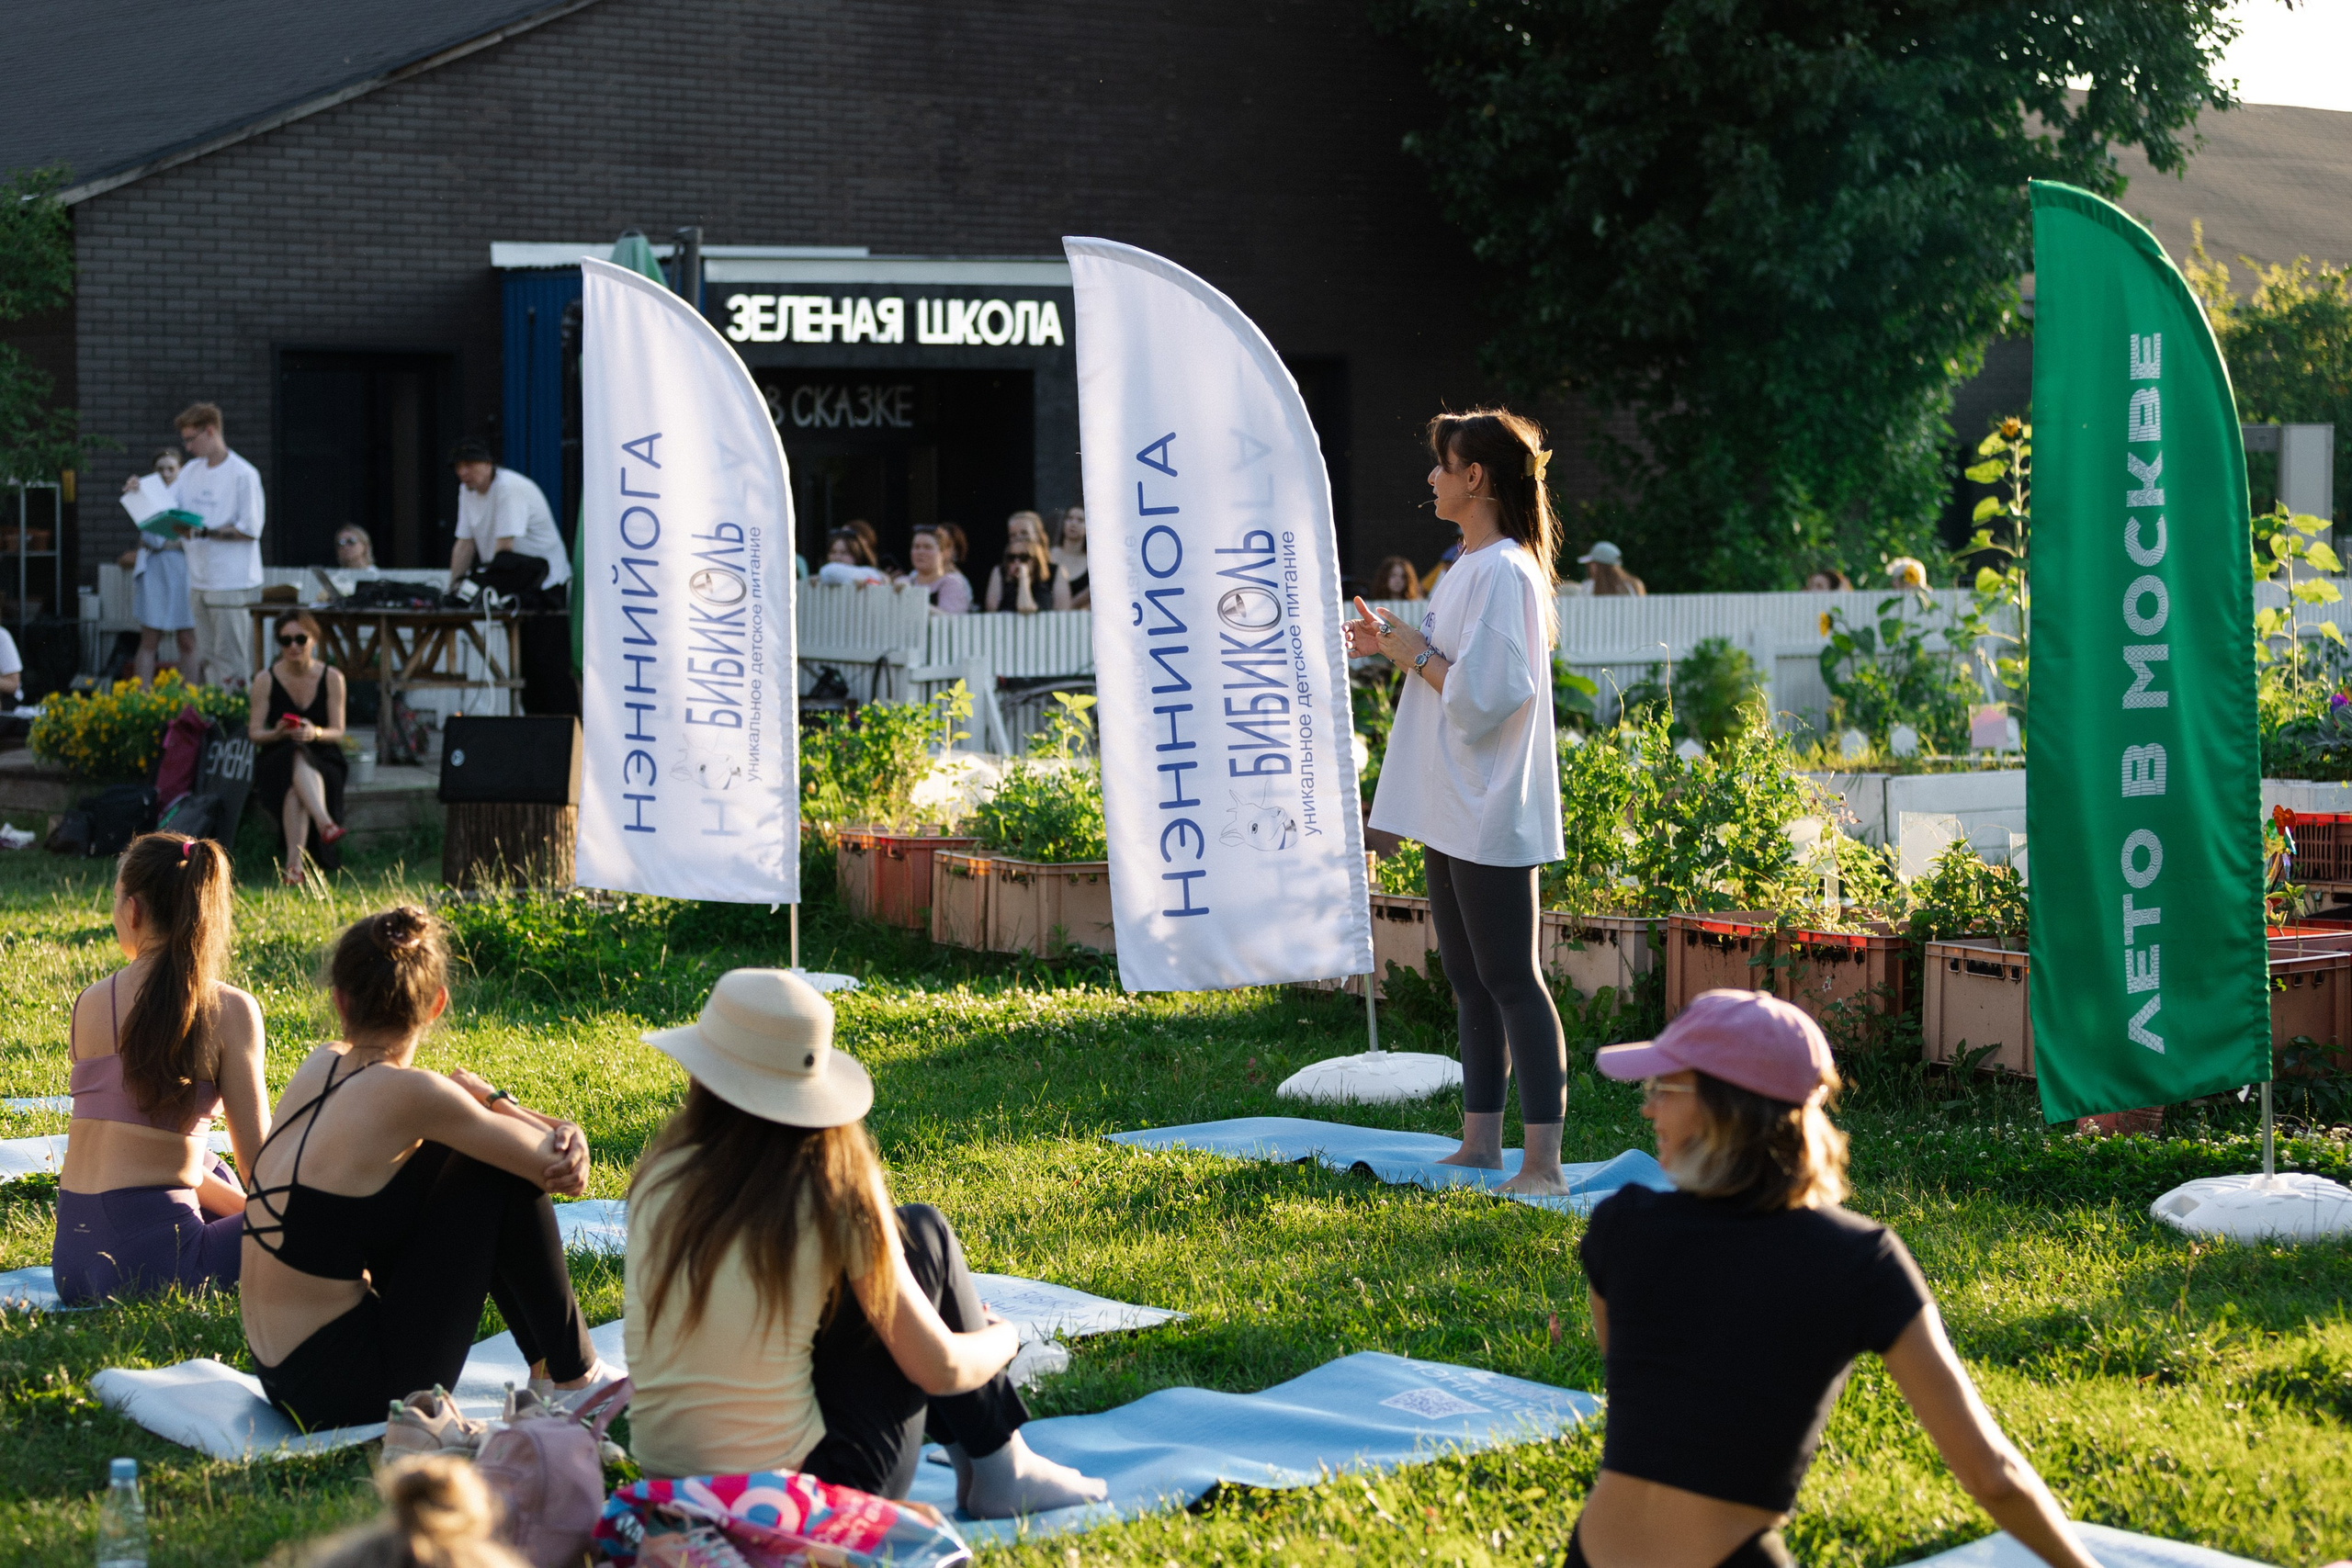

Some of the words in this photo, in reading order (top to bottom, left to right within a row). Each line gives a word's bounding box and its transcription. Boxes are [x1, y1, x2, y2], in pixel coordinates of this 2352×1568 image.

[726, 294, 904, 344] ЗЕЛЕНАЯ
[916, 298, 1065, 346] ШКОЛА
[791, 384, 914, 428] СКАЗКЕ
[749, 526, 763, 598] питание
[2122, 333, 2169, 709] МОСКВЕ
[685, 522, 747, 728] БИБИКОЛЬ
[1282, 531, 1301, 617] питание
[612, 433, 662, 833] НЭННИЙОГА
[752, 604, 764, 674] детское
[1132, 432, 1209, 918] НЭННИЙОГА
[1215, 529, 1293, 777] БИБИКОЛЬ
[1289, 624, 1312, 707] детское
[748, 679, 763, 782] уникальное
[1299, 714, 1321, 837] уникальное
[2121, 743, 2167, 797] В
[2120, 829, 2165, 1055] ЛЕТО
